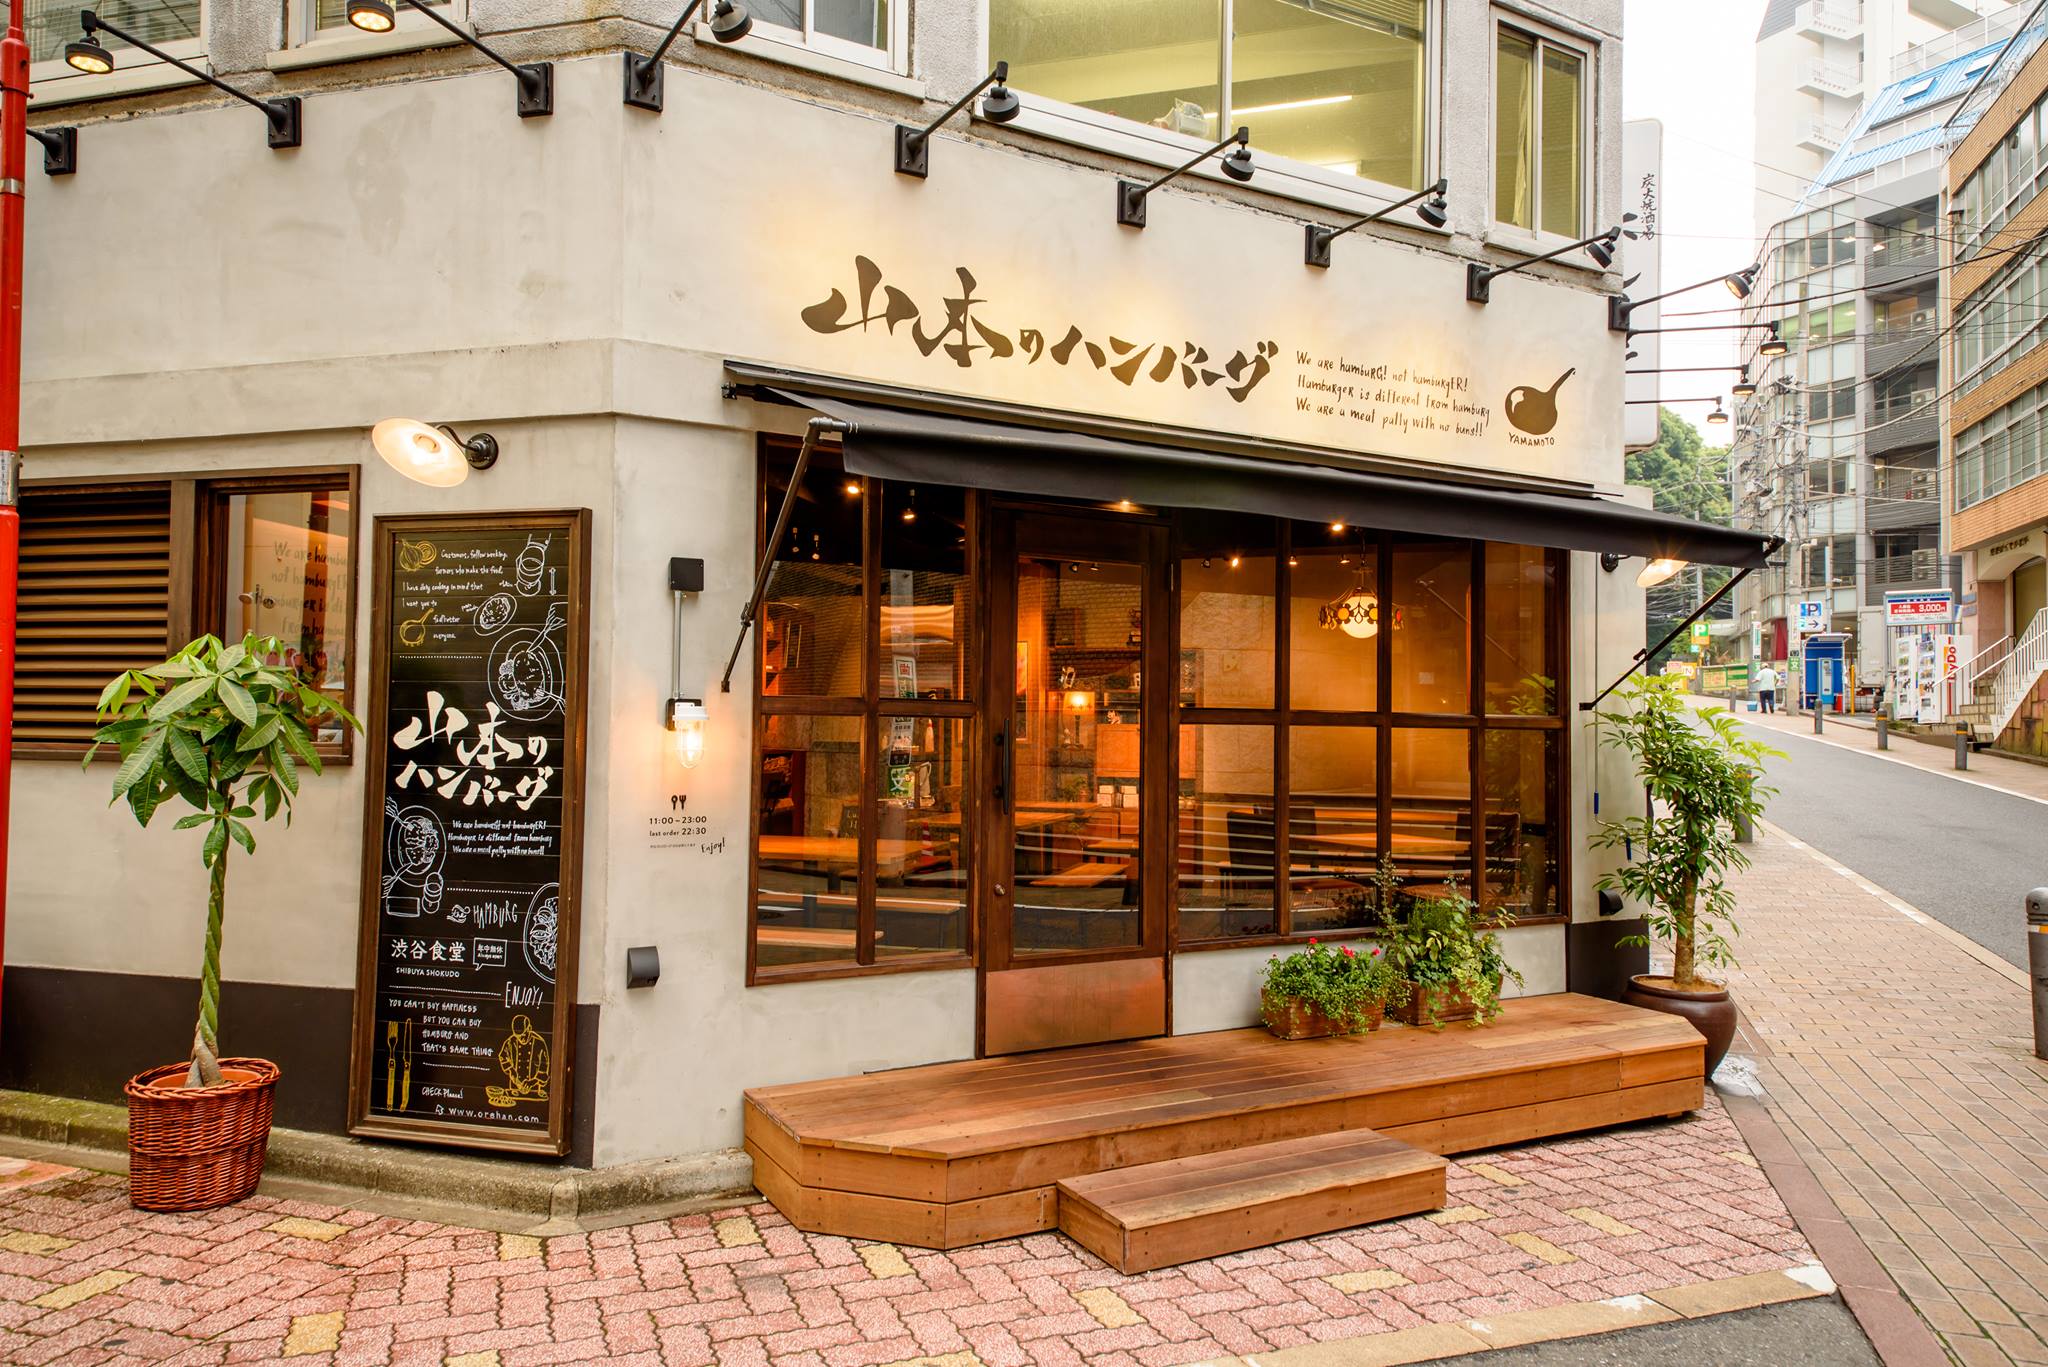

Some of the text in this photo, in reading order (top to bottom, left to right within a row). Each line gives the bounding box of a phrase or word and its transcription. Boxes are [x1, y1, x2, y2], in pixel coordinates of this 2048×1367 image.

[800, 255, 1279, 403] 山本のハンバーグ
[1296, 350, 1312, 366] We
[1392, 368, 1407, 382] not
[1360, 387, 1371, 401] is
[1296, 396, 1311, 412] We
[1339, 408, 1346, 417] a
[1412, 415, 1435, 430] with
[1439, 423, 1450, 432] no
[1508, 432, 1555, 447] YAMAMOTO
[393, 690, 548, 770] 山本の
[395, 760, 554, 811] ハンバーグ
[663, 829, 679, 837] order
[682, 827, 707, 836] 22:30
[473, 900, 518, 930] HAMBURG
[390, 938, 466, 963] 渋谷食堂
[396, 967, 460, 978] SHIBUYA SHOKUDO
[389, 998, 402, 1007] YOU
[427, 1002, 440, 1011] BUY
[441, 1002, 478, 1013] HAPPINESS
[505, 981, 543, 1010] ENJOY!
[423, 1015, 482, 1028] BUT YOU CAN BUY
[454, 1031, 469, 1040] AND
[421, 1042, 494, 1057] THAT'S SAME THING
